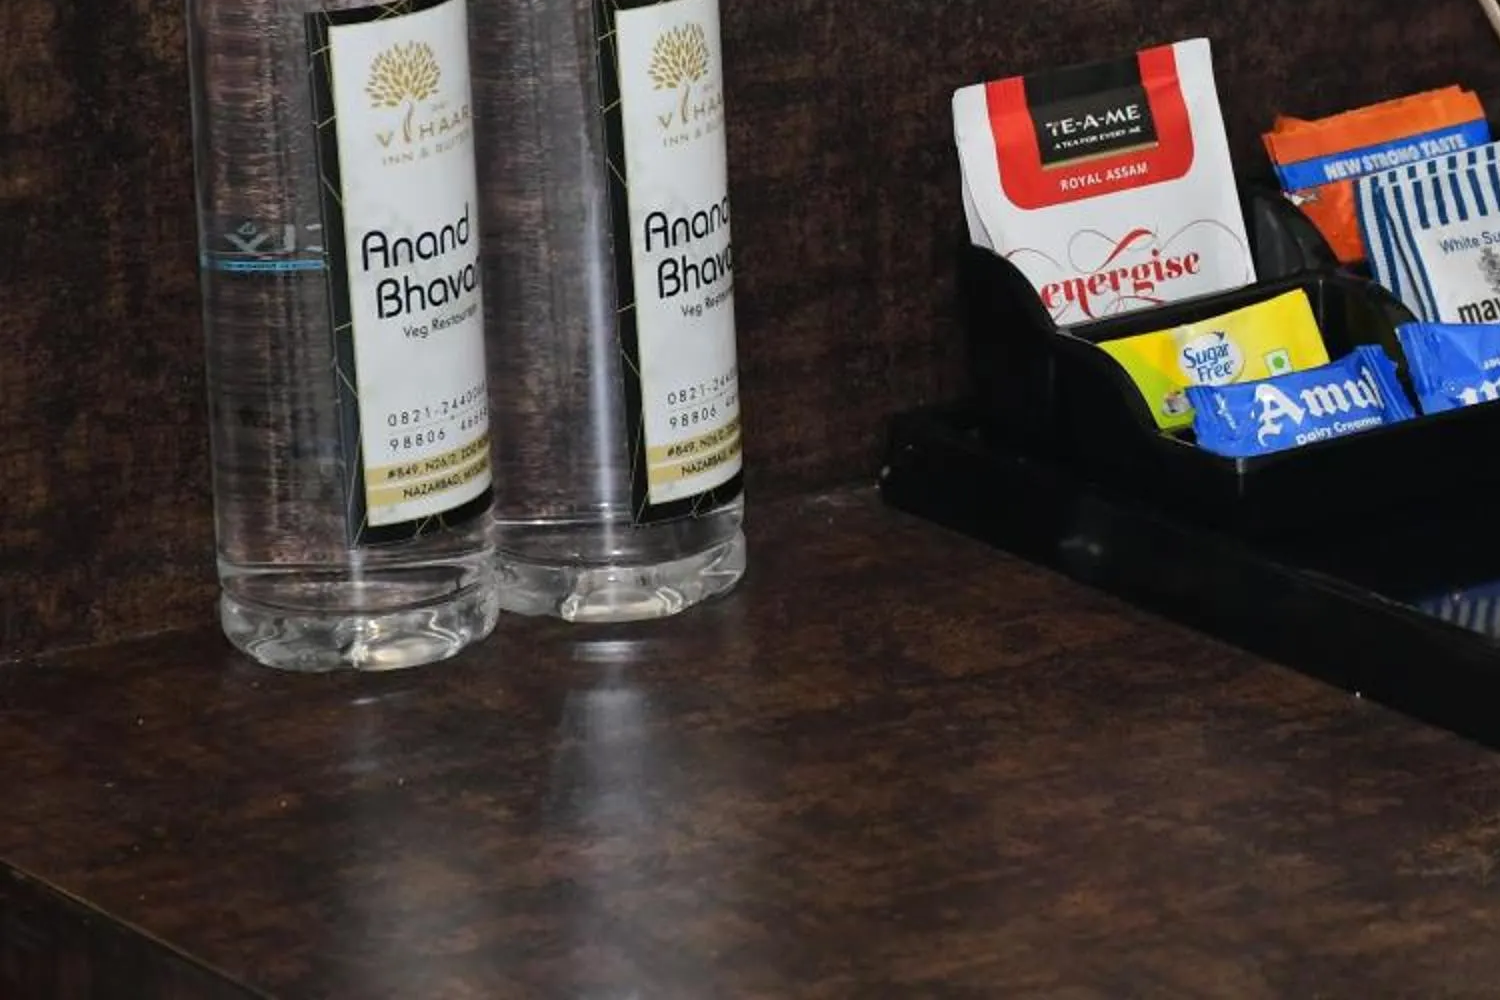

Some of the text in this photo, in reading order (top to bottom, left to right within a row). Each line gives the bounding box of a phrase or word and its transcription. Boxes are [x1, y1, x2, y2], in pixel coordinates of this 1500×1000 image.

[1045, 104, 1141, 136] TE-A-ME
[1323, 133, 1468, 181] NEW STRONG TASTE
[1060, 161, 1149, 192] ROYAL ASSAM
[361, 201, 470, 271] Anand
[1439, 236, 1481, 254] White
[1040, 248, 1200, 319] energise
[403, 324, 429, 339] Veg
[1183, 343, 1229, 369] Sugar
[1197, 359, 1232, 382] Free
[1251, 365, 1385, 447] Amul
